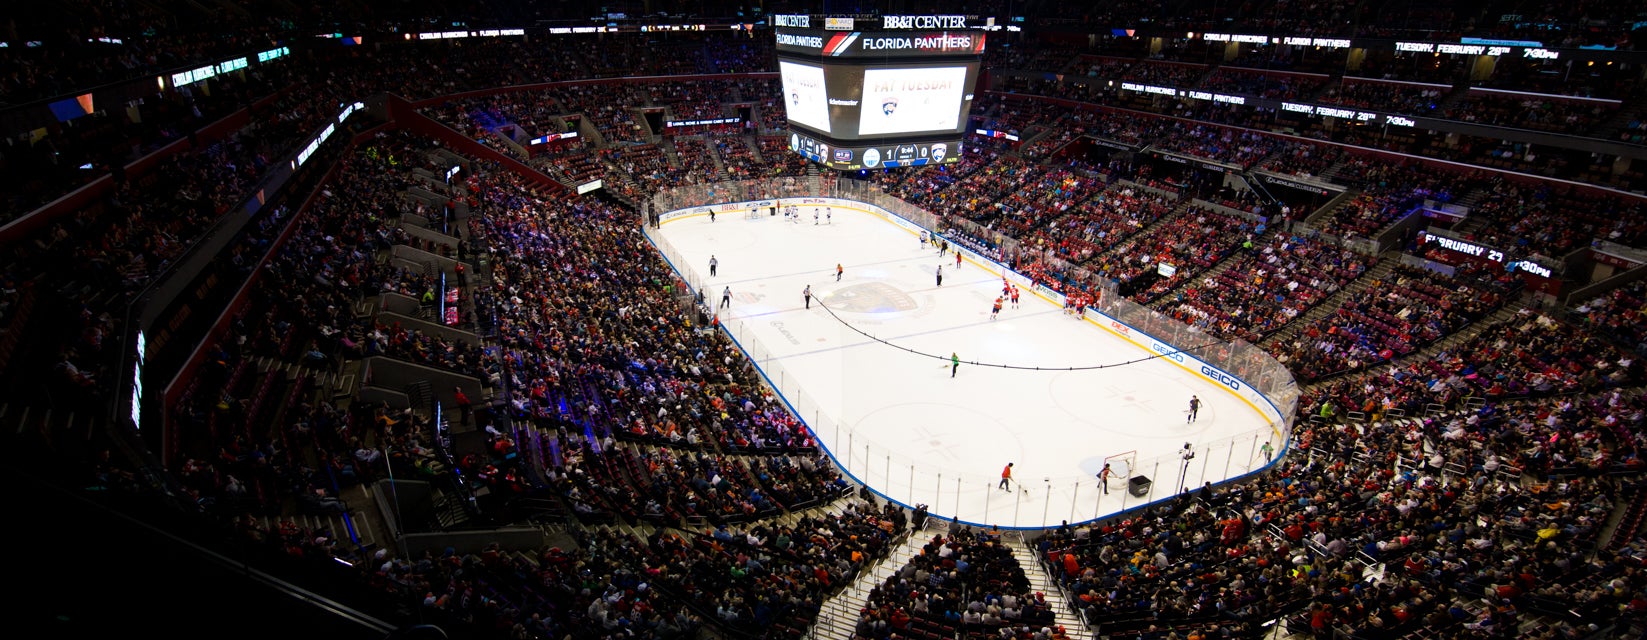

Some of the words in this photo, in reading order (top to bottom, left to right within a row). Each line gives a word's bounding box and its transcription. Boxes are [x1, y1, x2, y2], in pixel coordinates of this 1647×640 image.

[788, 15, 810, 28] CENTER
[883, 16, 915, 28] BB&T
[915, 16, 966, 28] CENTER
[776, 34, 796, 44] FLORIDA
[796, 36, 822, 48] PANTHERS
[862, 38, 912, 50] FLORIDA
[914, 37, 971, 48] PANTHERS
[1204, 33, 1230, 42] CAROLINA
[1231, 34, 1268, 44] HURRICANES
[1284, 36, 1312, 45] FLORIDA
[1313, 38, 1350, 48] PANTHERS
[1437, 44, 1484, 56] FEBRUARY
[901, 79, 953, 92] TUESDAY
[1122, 82, 1144, 92] CAROLINA
[1145, 85, 1176, 96] HURRICANES
[1189, 91, 1212, 100] FLORIDA
[1214, 94, 1245, 104] PANTHERS
[1316, 107, 1355, 119] FEBRUARY
[886, 150, 892, 159] 1
[921, 147, 928, 157] 0
[1153, 342, 1184, 363] GEICO
[1201, 366, 1240, 391] GEICO
